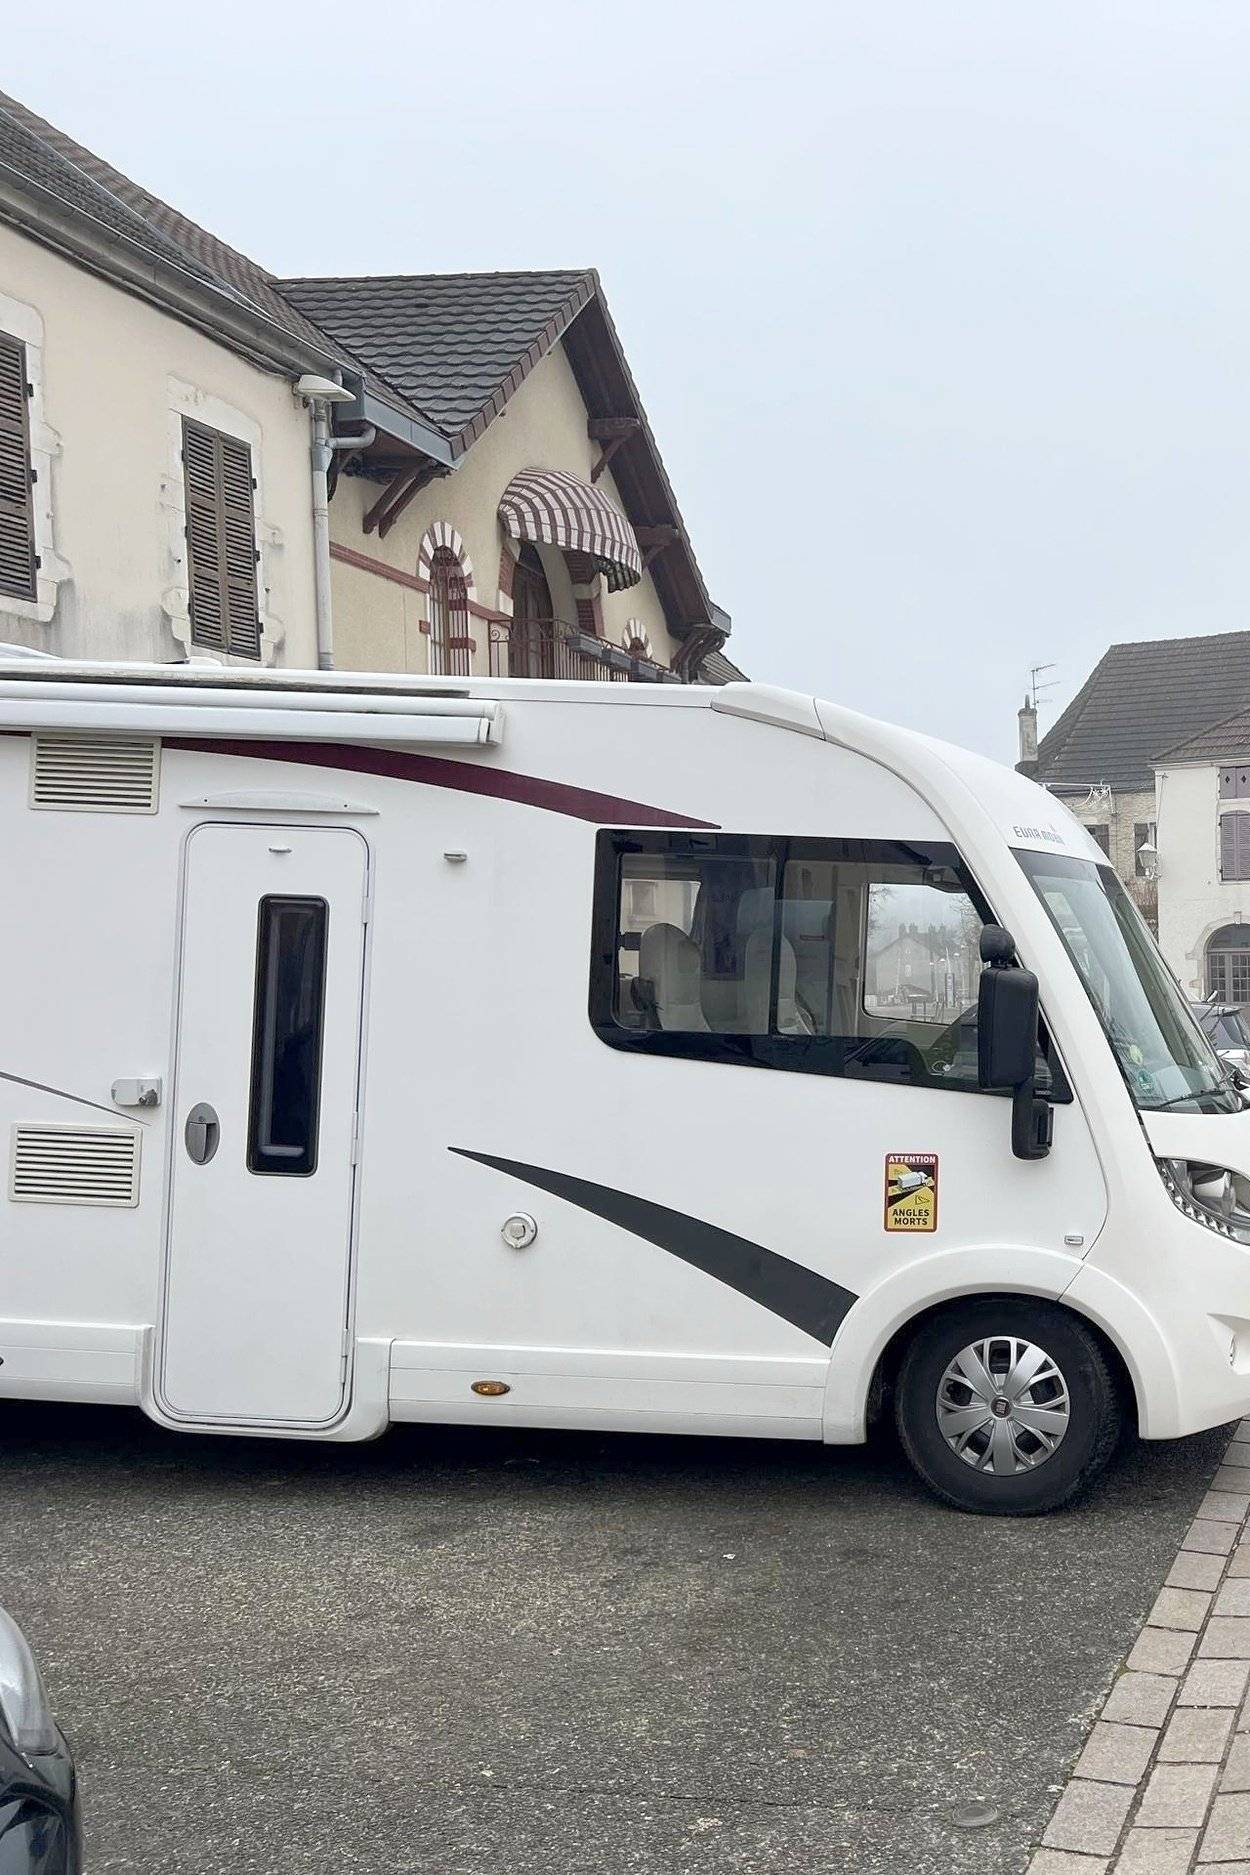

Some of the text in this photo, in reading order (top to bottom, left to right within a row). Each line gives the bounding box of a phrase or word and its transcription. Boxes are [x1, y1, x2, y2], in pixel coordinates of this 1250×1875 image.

[888, 1155, 936, 1164] ATTENTION
[892, 1208, 930, 1217] ANGLES
[894, 1217, 928, 1226] MORTS
